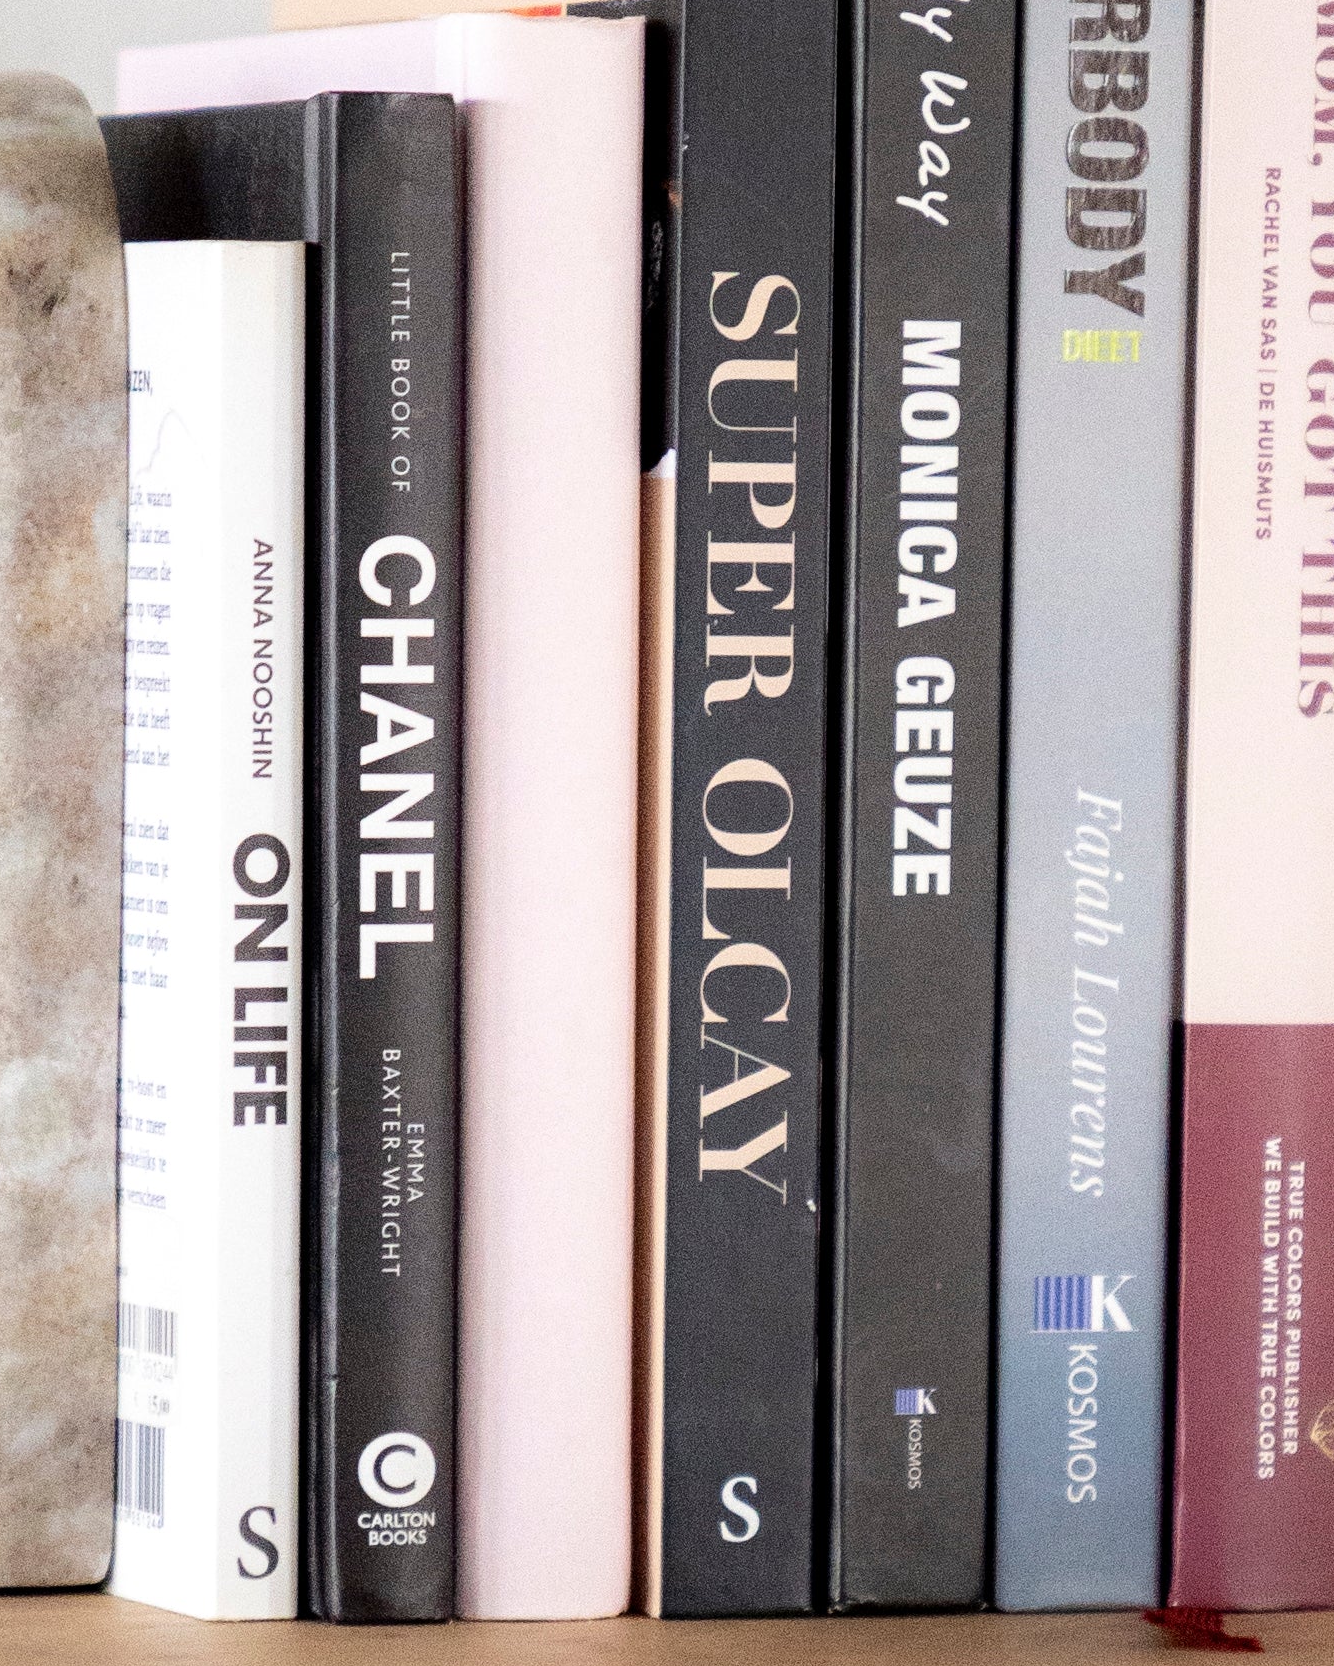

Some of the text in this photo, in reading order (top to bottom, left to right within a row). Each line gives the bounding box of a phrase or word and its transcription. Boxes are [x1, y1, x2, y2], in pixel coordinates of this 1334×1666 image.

[895, 70, 971, 227] Way
[1261, 165, 1283, 257] RACHEL
[1258, 315, 1279, 364] SAS
[1259, 263, 1280, 311] VAN
[390, 251, 412, 492] LITTLE BOOK OF
[1063, 329, 1142, 363] DIEET
[1255, 379, 1279, 413] DE
[1253, 418, 1276, 542] HUISMUTS
[251, 538, 274, 779] ANNA NOOSHIN
[892, 319, 962, 897] MONICA GEUZE
[358, 534, 437, 979] CHANEL
[698, 271, 799, 1205] SUPER OLCAY
[232, 833, 292, 1126] ON LIFE
[1064, 788, 1124, 1197] Fajah Lourens
[381, 1048, 403, 1277] BAXTER-WRIGHT
[406, 1122, 425, 1202] EMMA
[1090, 1274, 1132, 1332] K
[1255, 1135, 1285, 1483] WE BUILD WITH TRUE COLORS
[1279, 1160, 1307, 1457] TRUE COLORS PUBLISHER
[372, 1443, 417, 1496] C
[907, 1418, 923, 1491] KOSMOS
[1066, 1342, 1099, 1504] KOSMOS
[237, 1505, 280, 1580] S
[357, 1511, 436, 1529] CARLTON
[368, 1530, 428, 1546] BOOKS
[719, 1475, 761, 1543] S
